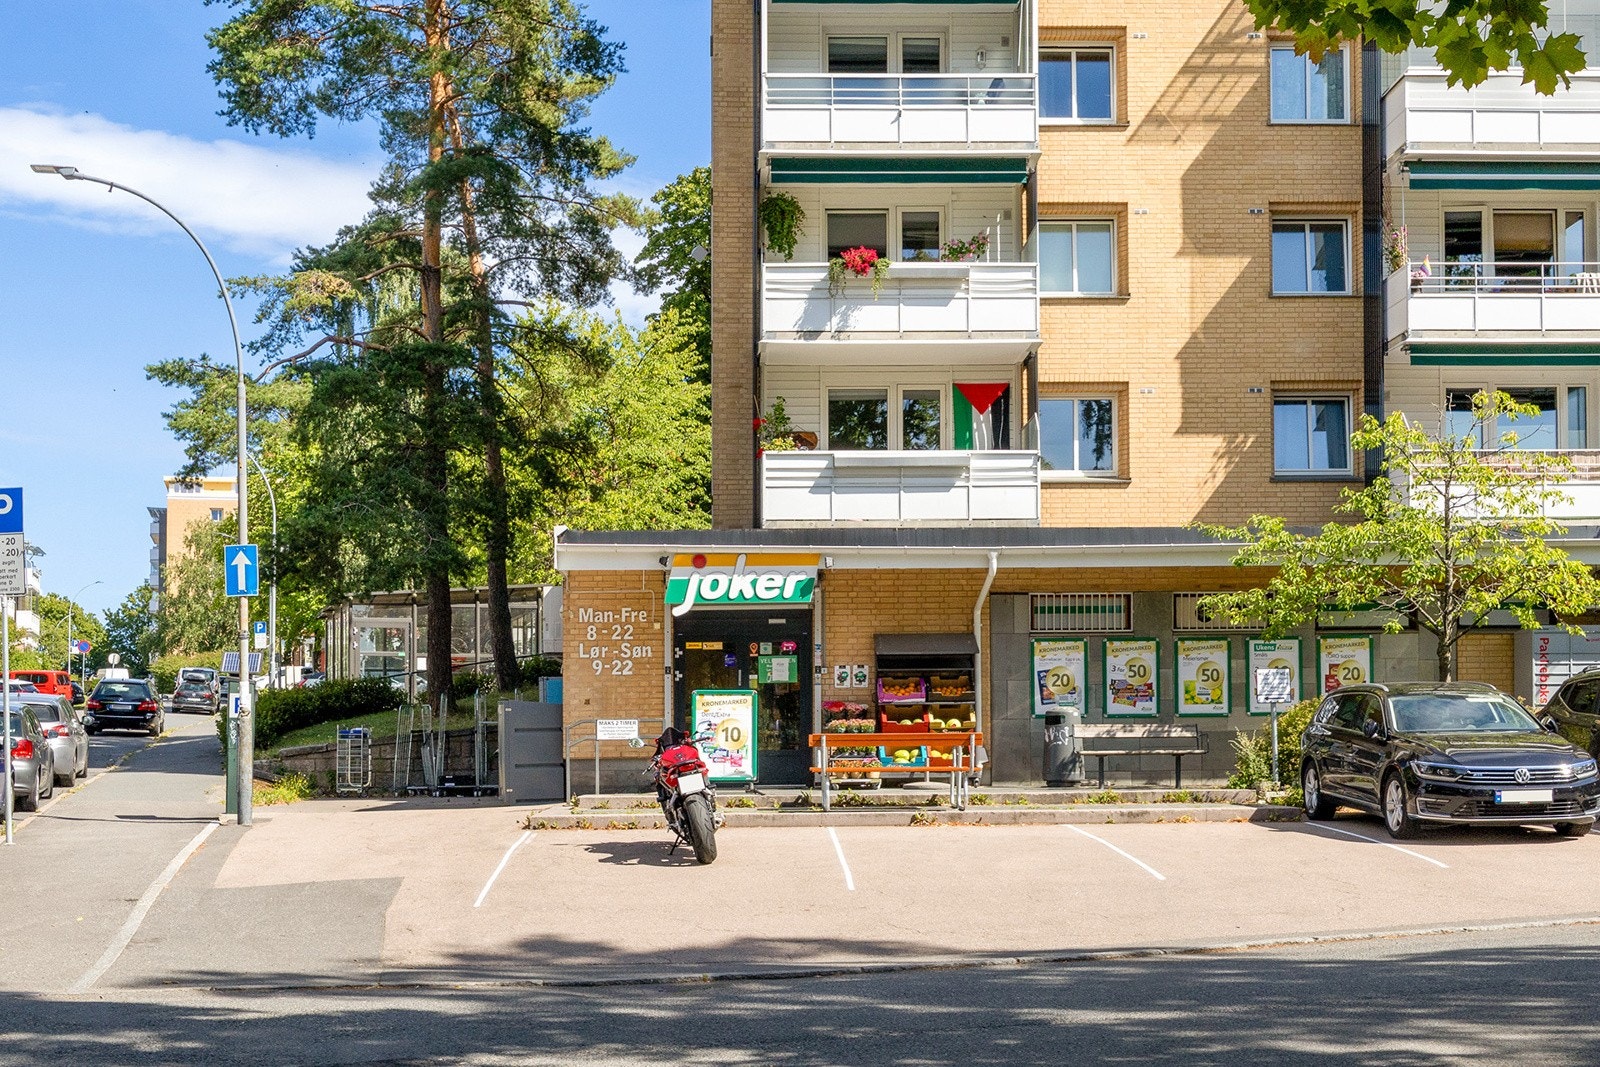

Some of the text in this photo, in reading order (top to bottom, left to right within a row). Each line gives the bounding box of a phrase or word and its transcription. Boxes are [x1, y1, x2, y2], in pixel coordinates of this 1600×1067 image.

[672, 553, 807, 617] joker
[579, 607, 647, 623] Man-Fre
[1128, 664, 1147, 679] 50
[1201, 668, 1220, 682] 50
[1342, 666, 1360, 681] 20
[1051, 673, 1070, 687] 20
[701, 698, 748, 707] KRONEMARKED
[721, 726, 741, 742] 10
